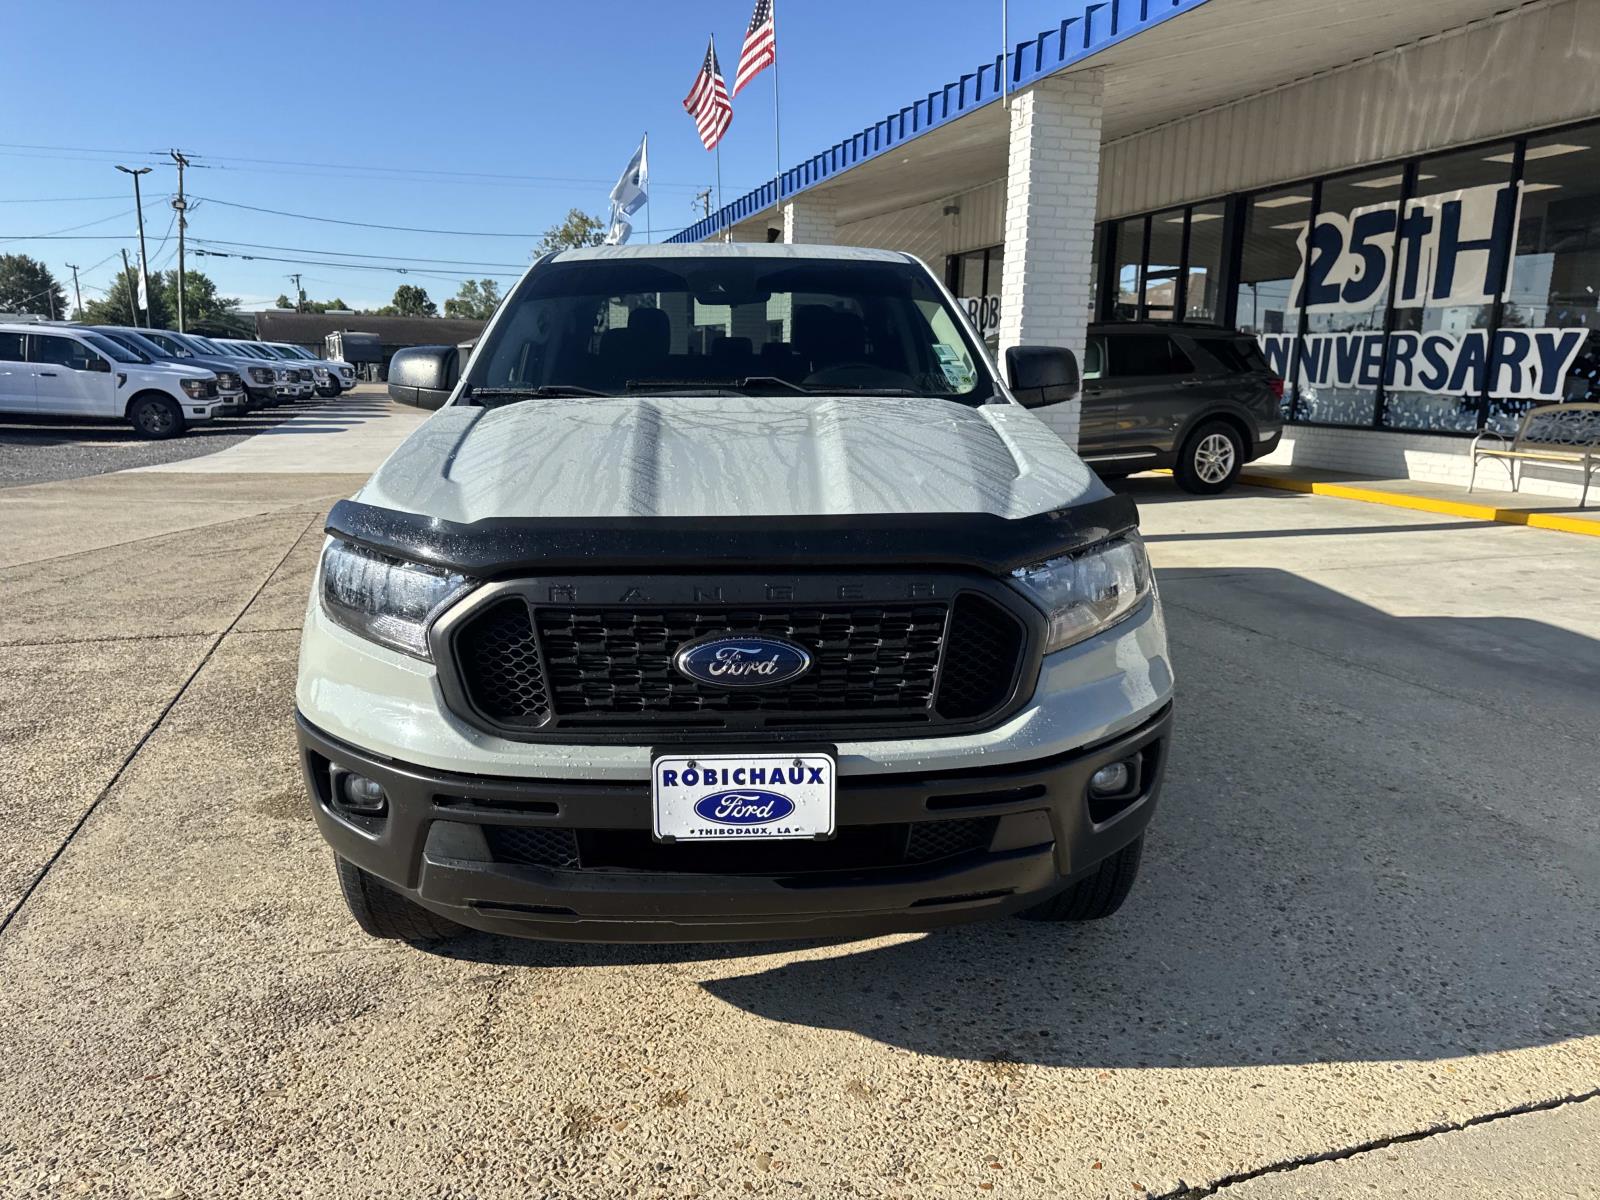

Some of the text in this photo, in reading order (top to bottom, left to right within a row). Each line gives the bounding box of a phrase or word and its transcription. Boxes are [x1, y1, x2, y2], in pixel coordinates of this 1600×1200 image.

[1263, 332, 1582, 395] NNIVERSARY
[548, 583, 937, 602] RANGER
[708, 647, 781, 676] Ford
[662, 767, 825, 787] ROBICHAUX
[714, 794, 775, 818] Ford
[698, 826, 791, 836] THIBODAUX, LA
